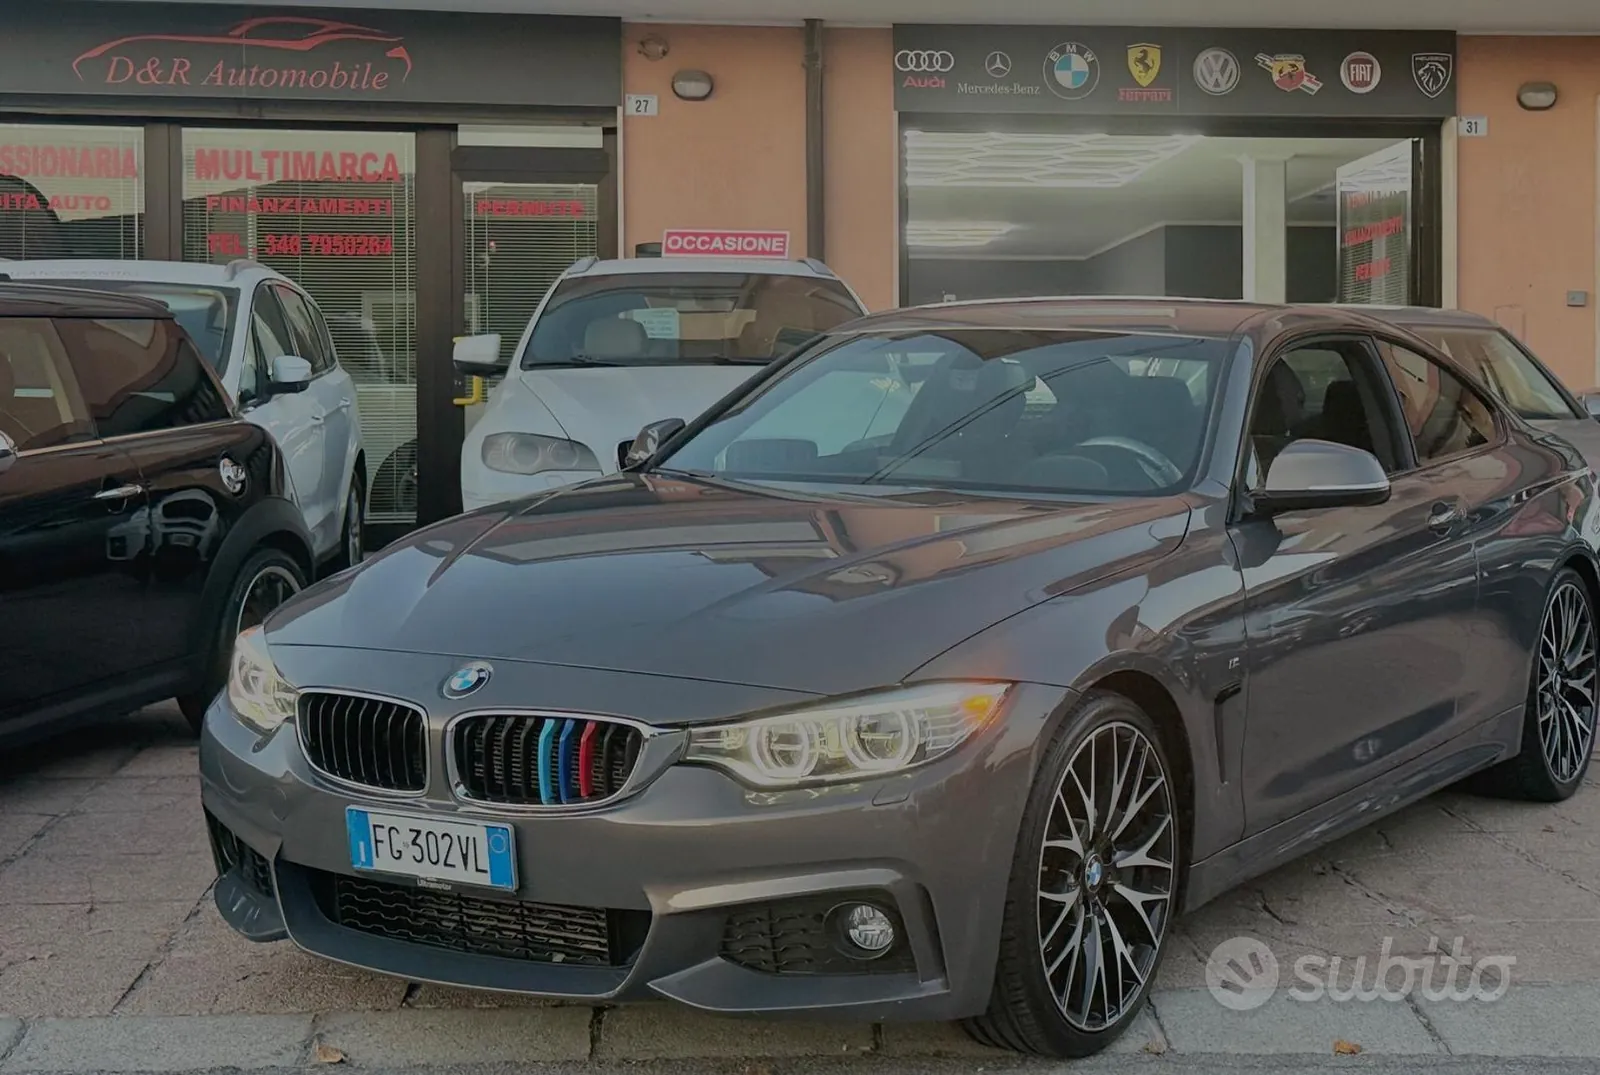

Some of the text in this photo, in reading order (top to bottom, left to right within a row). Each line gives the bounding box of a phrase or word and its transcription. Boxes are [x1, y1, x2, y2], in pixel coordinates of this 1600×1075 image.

[105, 56, 390, 90] D&R Automobile
[1350, 63, 1373, 82] FIAT
[903, 75, 946, 88] Audi
[957, 82, 1041, 96] Mercedes-Benz
[1118, 87, 1173, 102] Ferrari
[635, 99, 649, 113] 27
[1466, 120, 1478, 134] 31
[194, 148, 401, 183] MULTIMARCA
[48, 194, 111, 210] AUTO
[207, 195, 392, 215] FINANZIAMENTI
[667, 236, 784, 252] OCCASIONE
